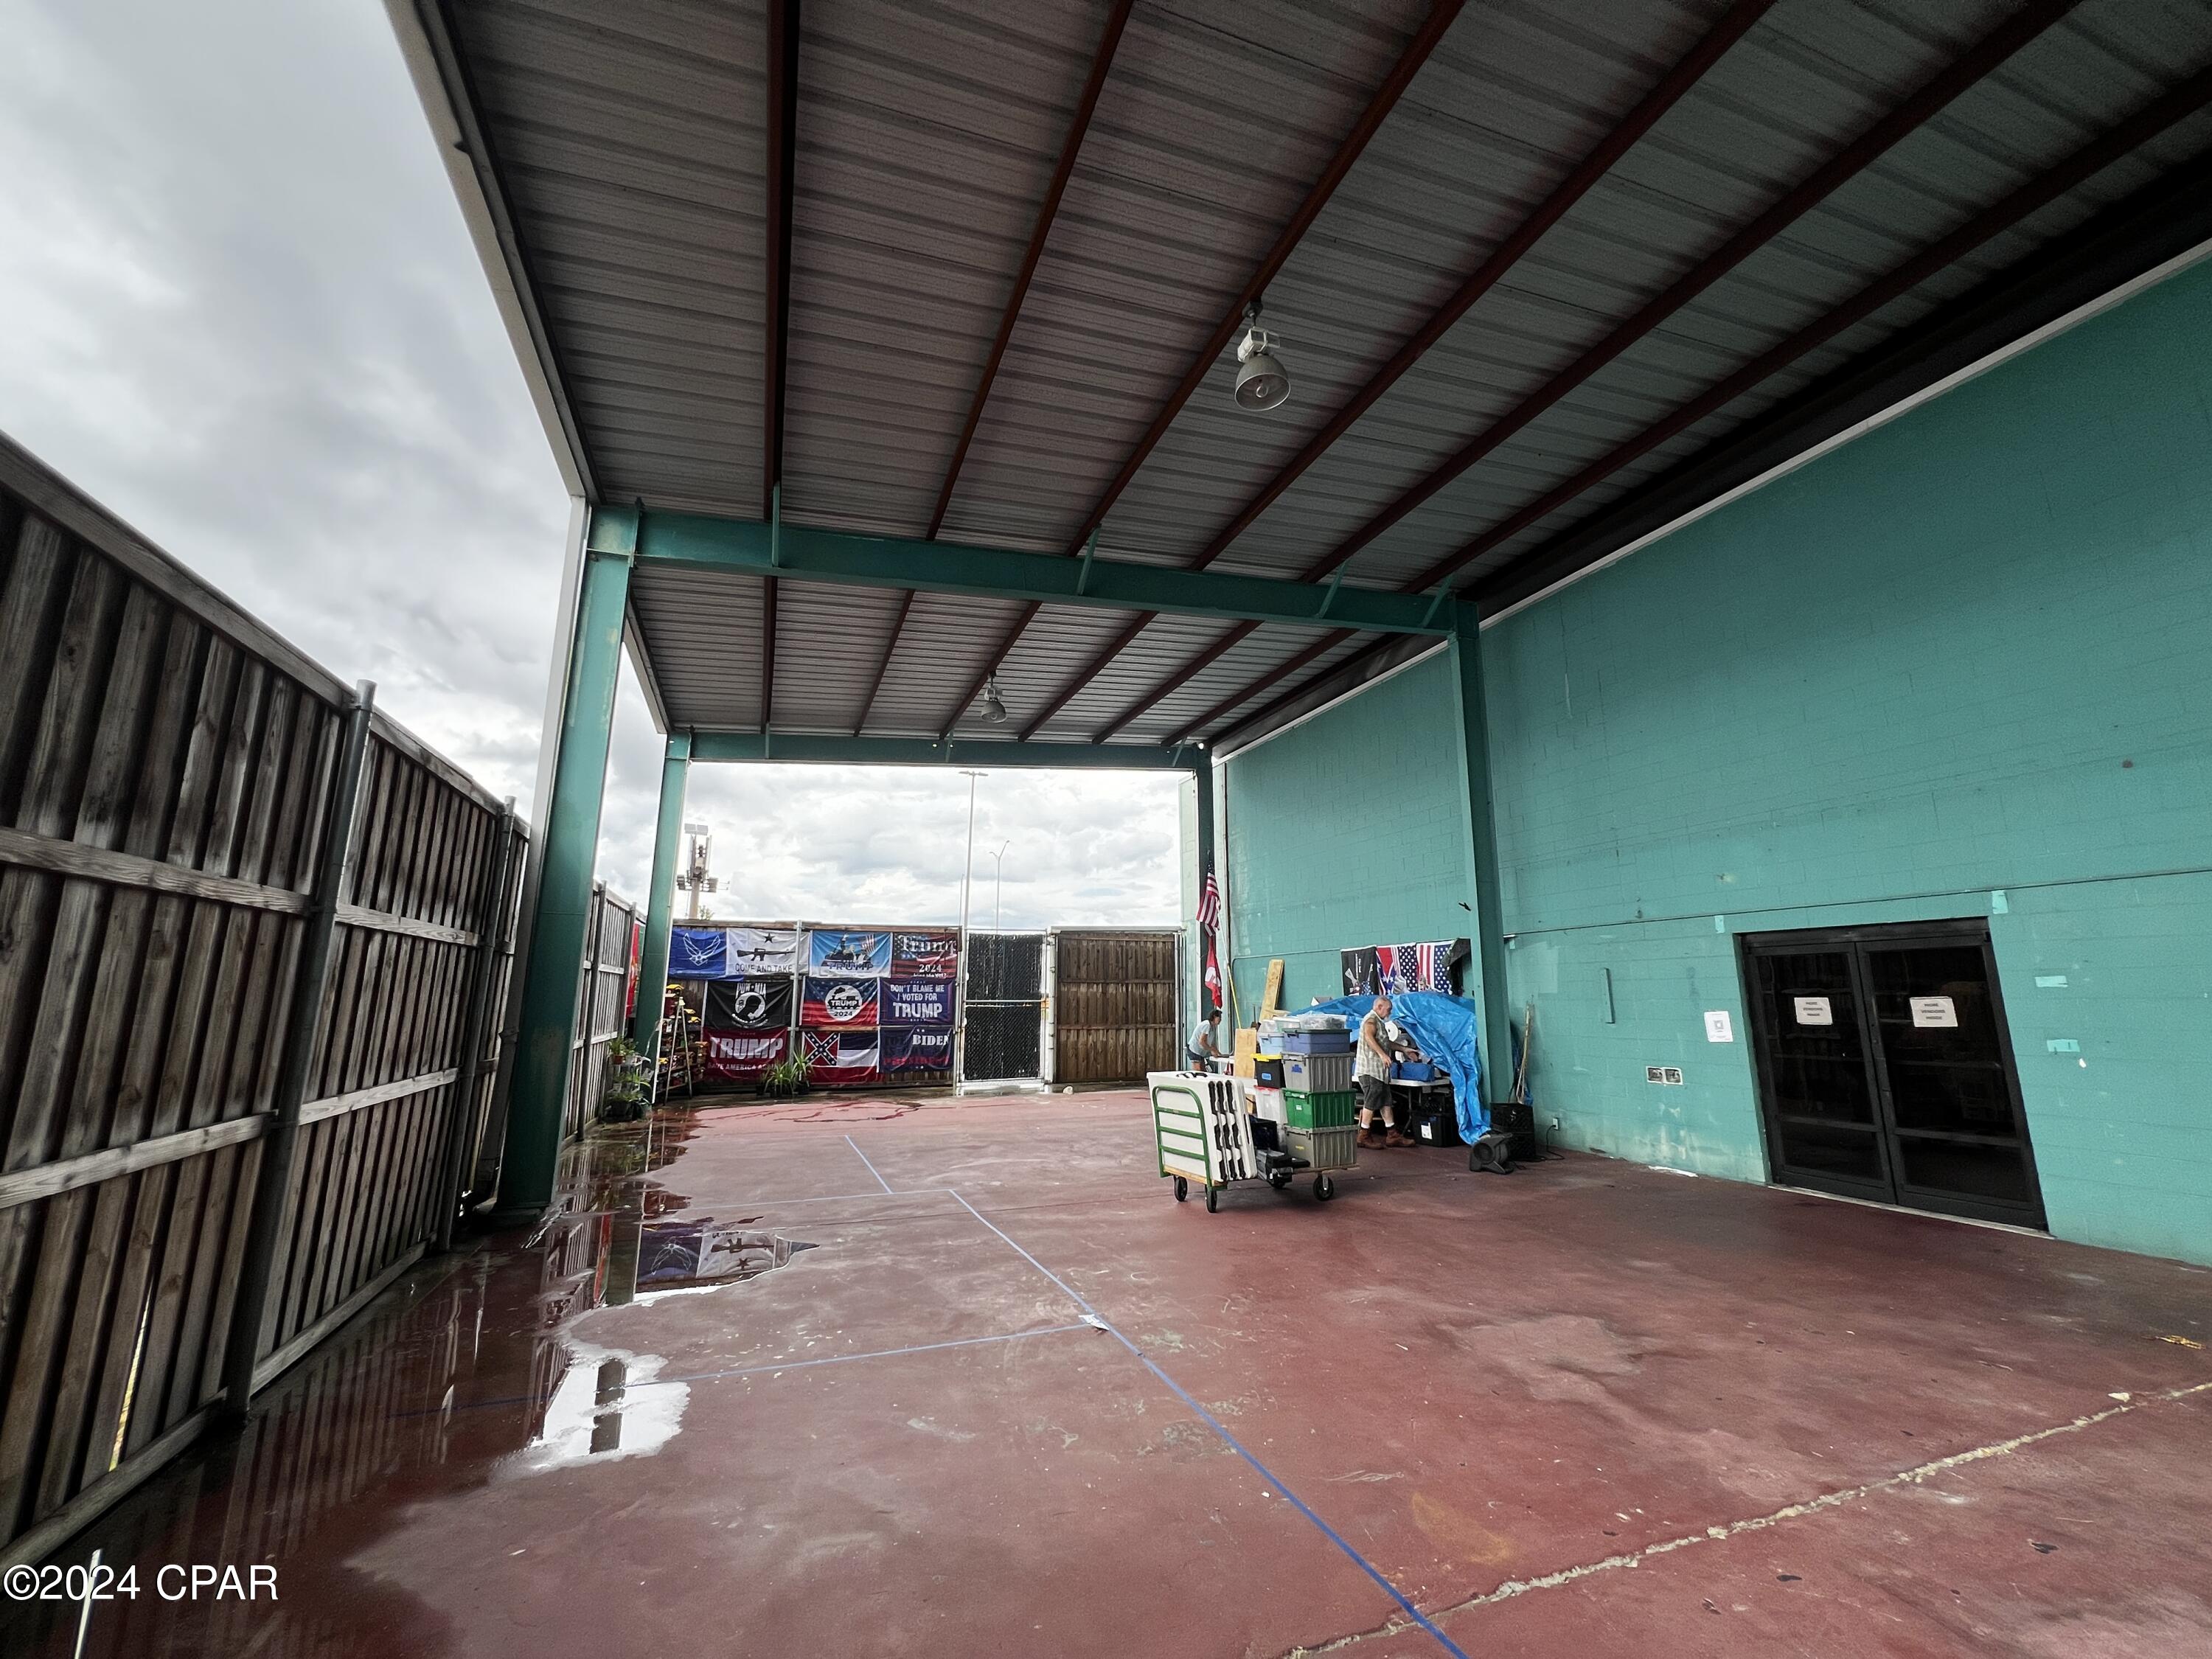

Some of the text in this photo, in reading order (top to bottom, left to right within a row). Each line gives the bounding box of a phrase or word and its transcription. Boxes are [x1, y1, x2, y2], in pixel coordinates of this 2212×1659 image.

[735, 963, 792, 973] COME AND TAKE
[827, 961, 874, 970] TRUMP
[919, 964, 942, 973] 2024
[890, 984, 945, 992] DON'T BLAME ME
[902, 993, 923, 1001] VOTED
[925, 992, 938, 1001] FOR
[892, 1002, 943, 1018] TRUMP
[912, 1034, 950, 1046] BIDEN
[709, 1037, 783, 1060] TRUMP
[725, 1062, 757, 1071] AMERICA
